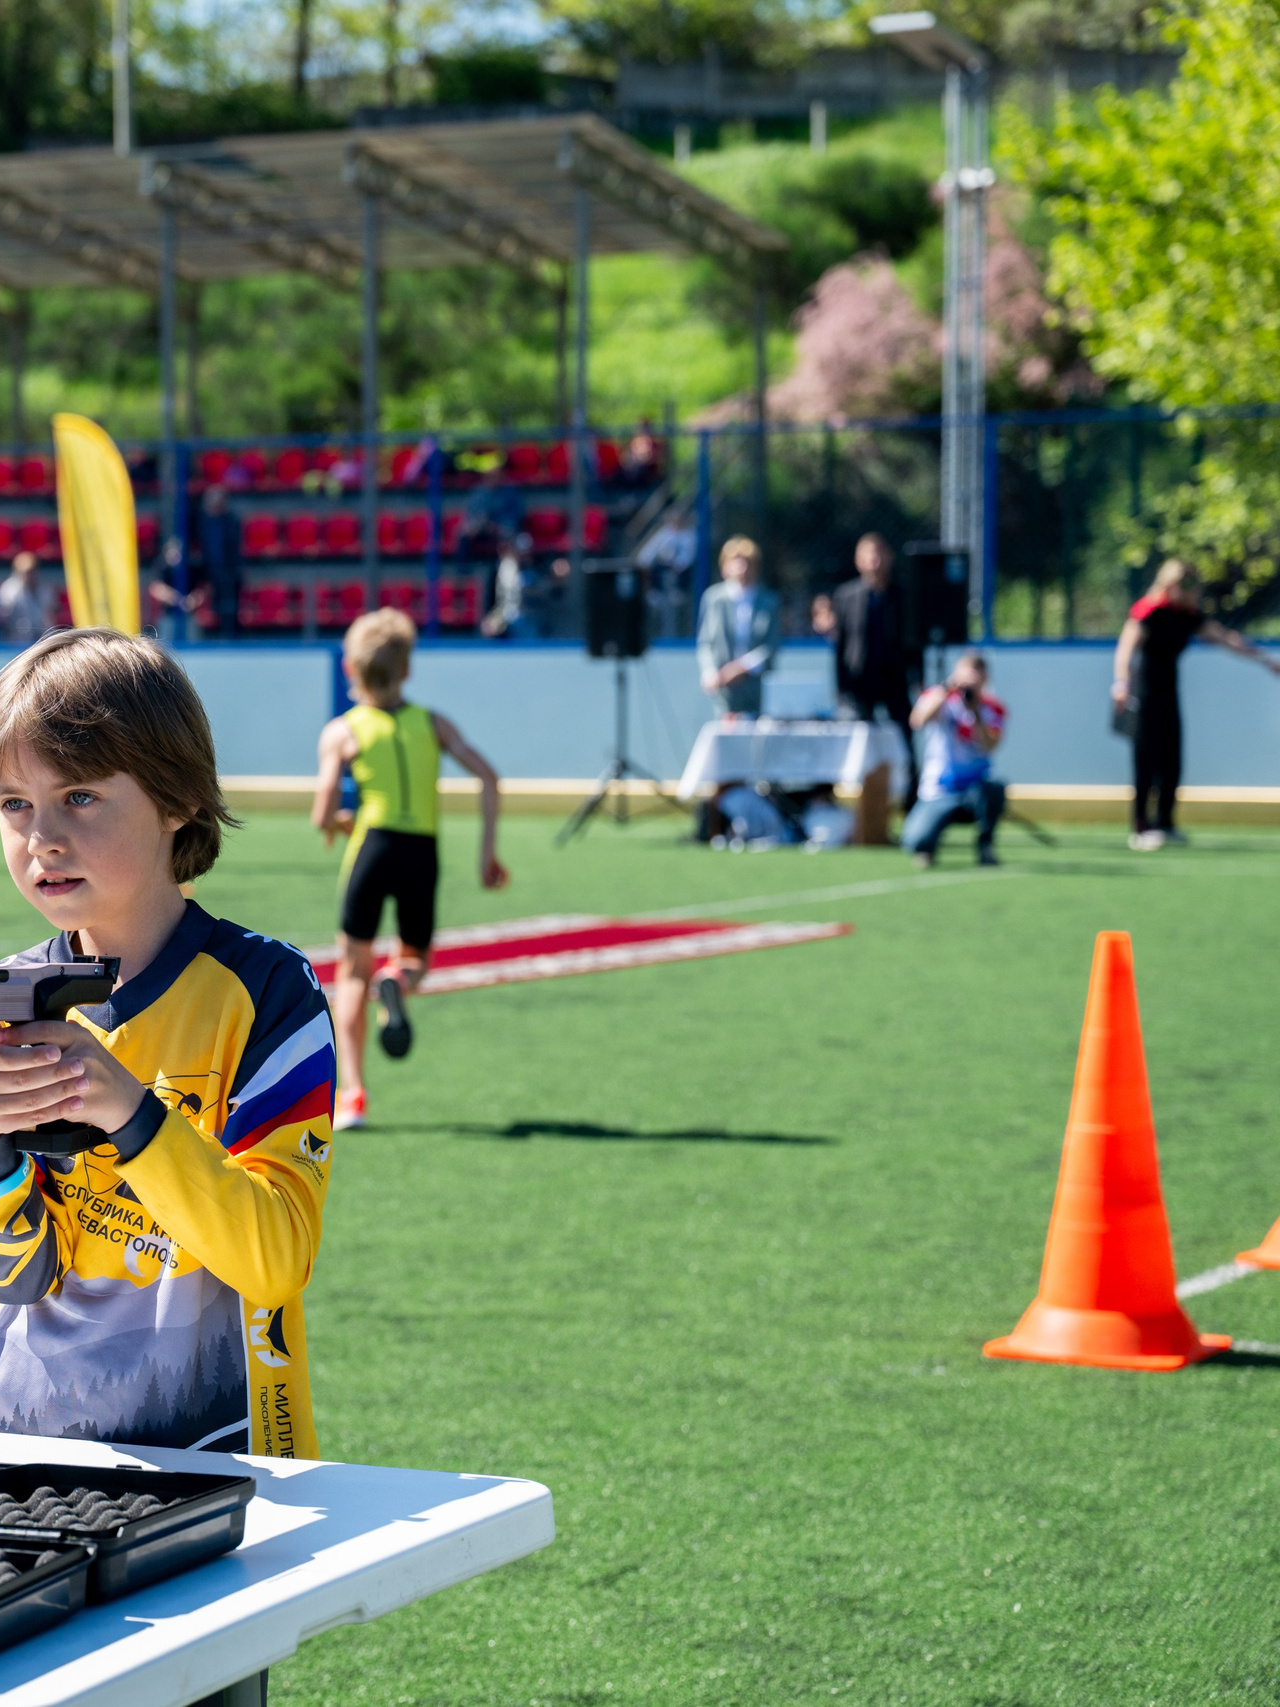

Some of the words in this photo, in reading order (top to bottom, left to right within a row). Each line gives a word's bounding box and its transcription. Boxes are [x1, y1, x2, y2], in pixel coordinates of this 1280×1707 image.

[54, 1179, 144, 1231] ЕСПУБЛИКА
[260, 1386, 273, 1456] ПОКОЛЕНИЕ
[274, 1383, 295, 1459] МИЛЛЕ
